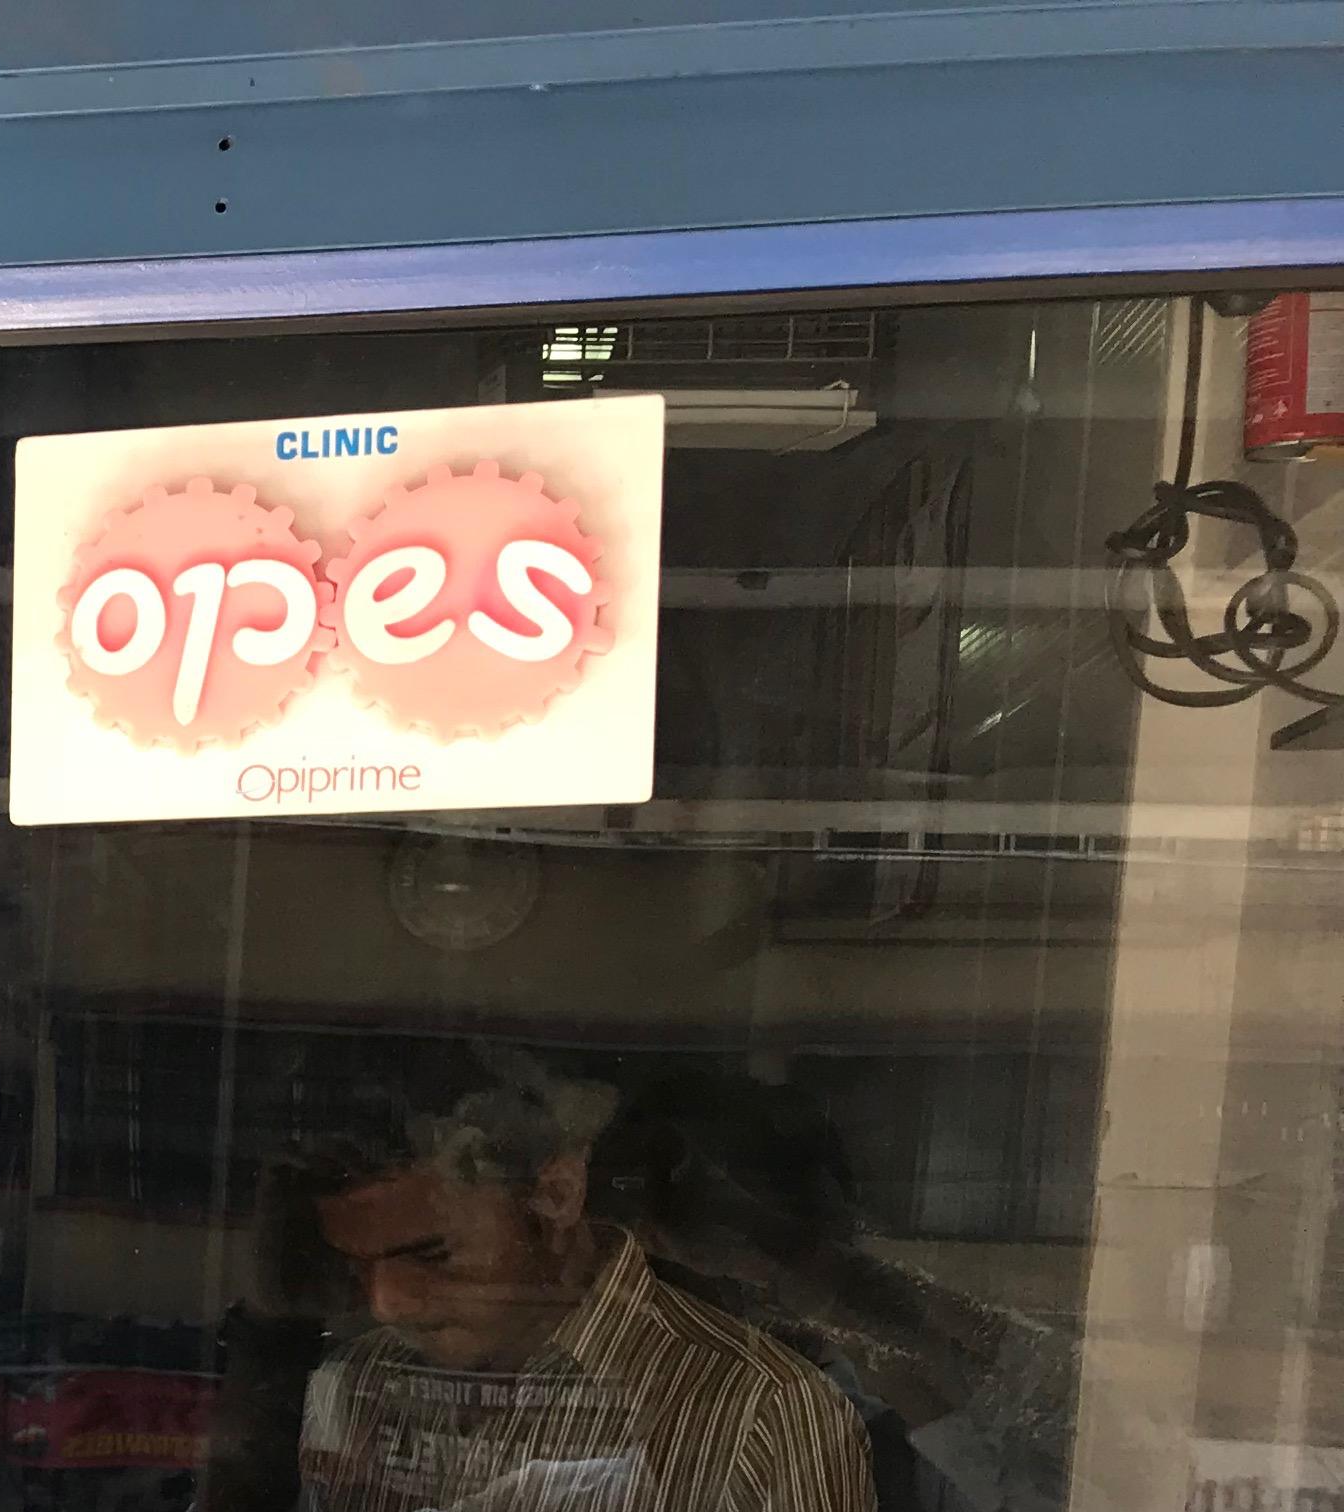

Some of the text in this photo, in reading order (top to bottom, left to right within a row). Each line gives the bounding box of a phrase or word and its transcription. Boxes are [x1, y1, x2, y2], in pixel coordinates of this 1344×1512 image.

[275, 425, 400, 461] CLINIC
[70, 539, 595, 728] opes
[234, 756, 423, 804] Opiprime
